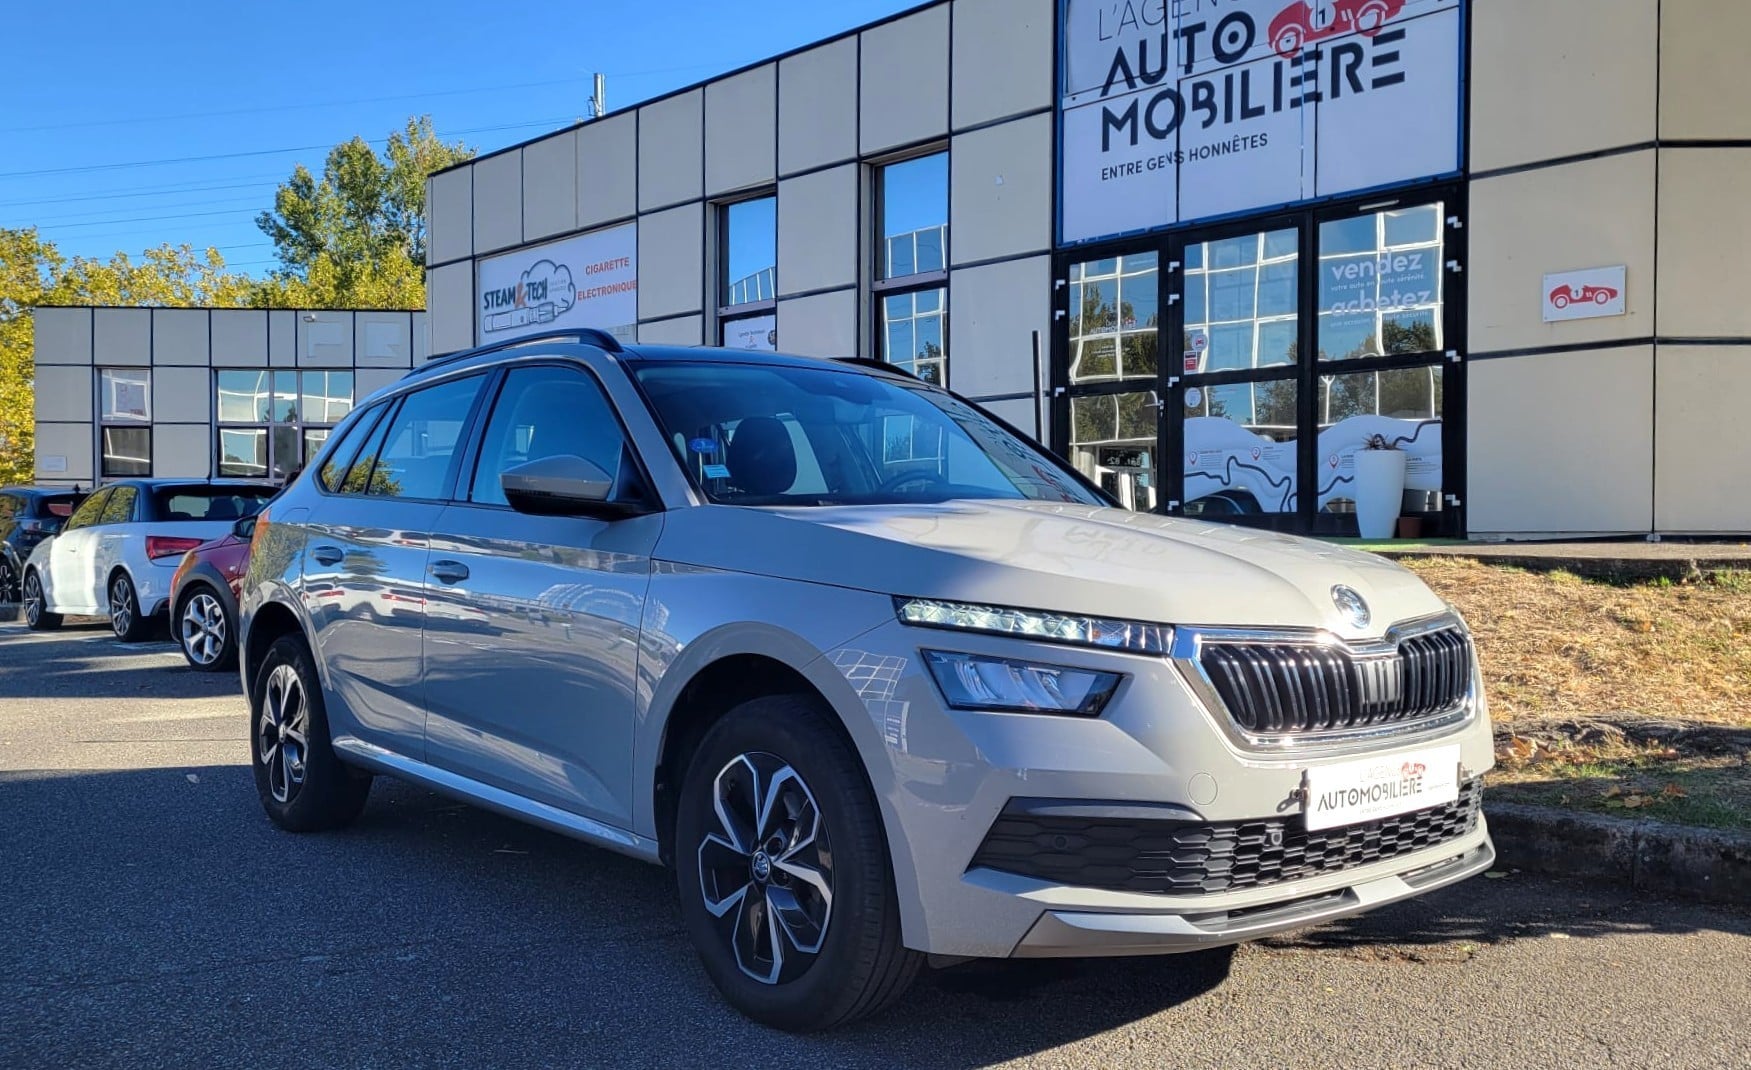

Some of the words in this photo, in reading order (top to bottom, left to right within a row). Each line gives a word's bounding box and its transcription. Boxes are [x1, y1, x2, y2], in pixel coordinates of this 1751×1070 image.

[1318, 8, 1326, 25] 1
[1100, 11, 1256, 98] AUTO
[1101, 28, 1406, 152] MOBILIERE
[1101, 160, 1143, 181] ENTRE
[1146, 150, 1185, 170] GENS
[1189, 133, 1269, 162] HONNÊTES
[585, 257, 629, 275] CIGARETTE
[1332, 252, 1422, 280] vendez
[577, 280, 637, 301] ELECTRONIQUE
[1331, 290, 1431, 317] achetez
[1317, 775, 1423, 812] AUTOMOBILIERE
